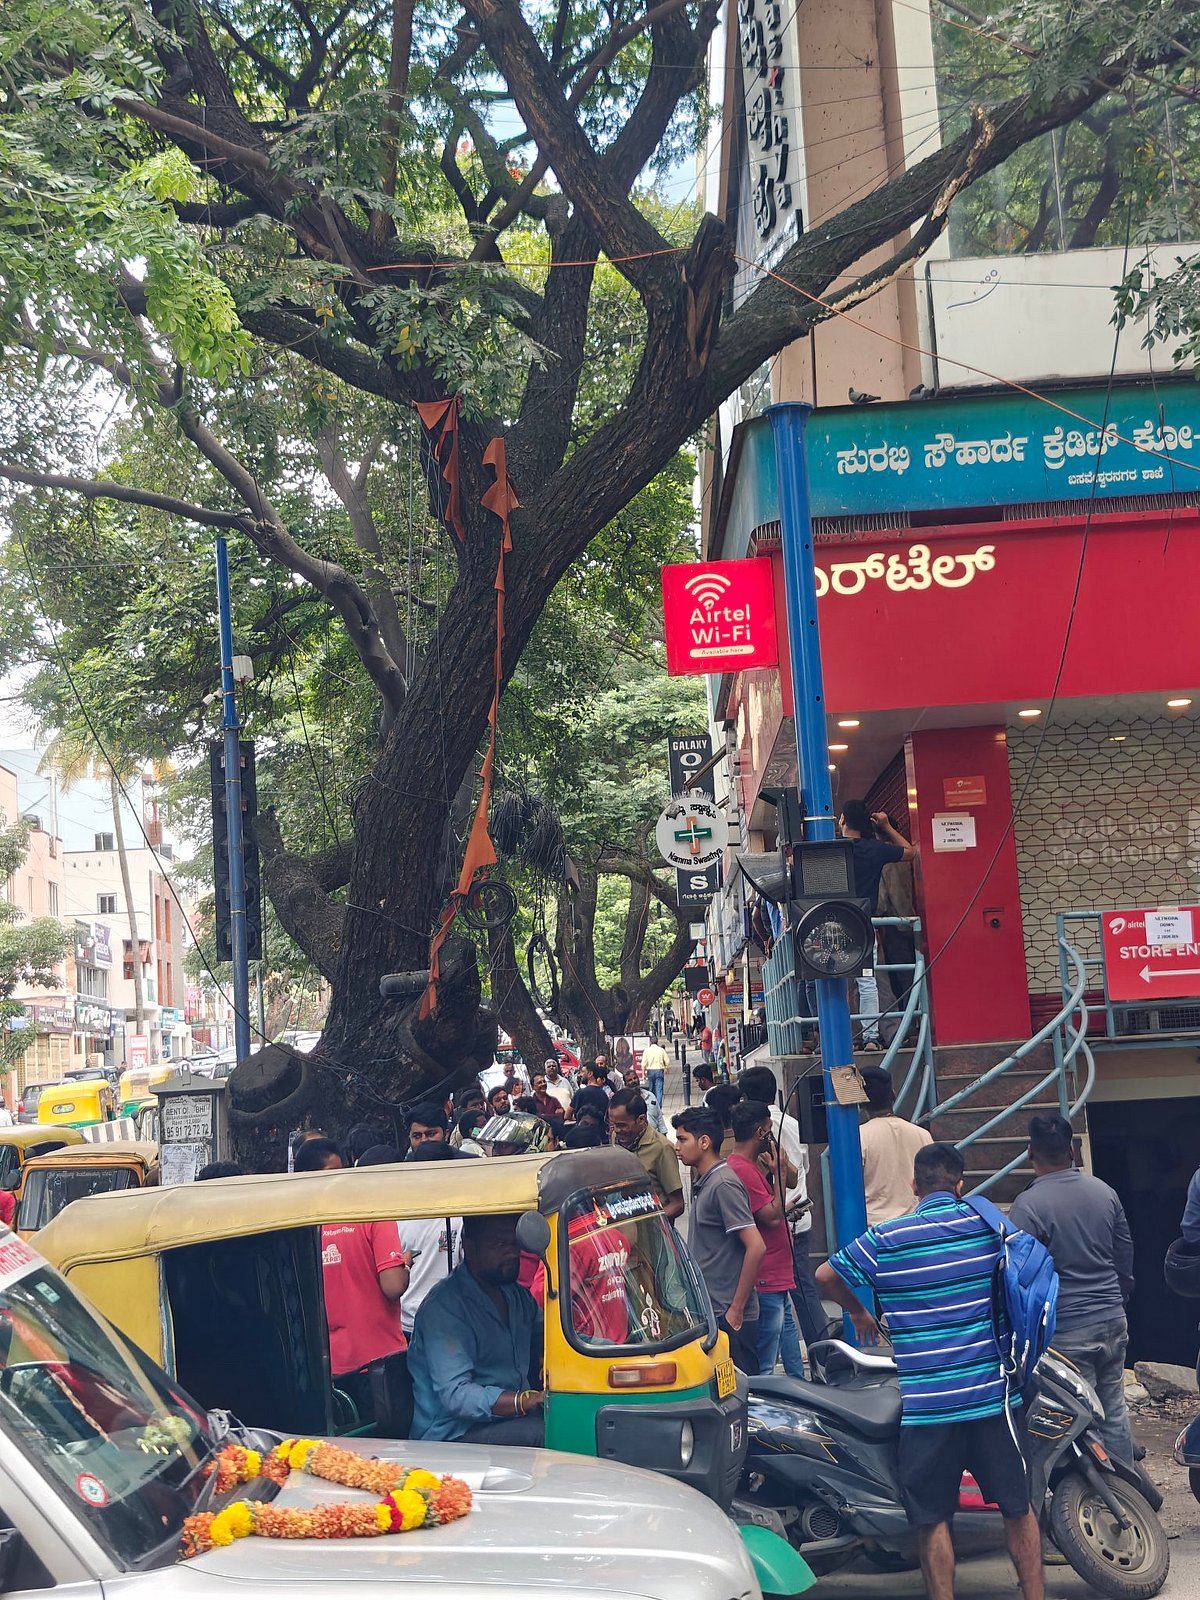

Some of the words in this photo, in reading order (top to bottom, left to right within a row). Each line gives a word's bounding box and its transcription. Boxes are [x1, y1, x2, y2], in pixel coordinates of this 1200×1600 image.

[836, 441, 911, 475] ಸುರಭಿ
[1043, 422, 1119, 469] ಕ್ರೆಡಿಟ್
[689, 603, 751, 625] Airtel
[691, 624, 751, 645] Wi-Fi
[672, 739, 708, 751] GALAXY
[667, 851, 693, 866] Namma
[693, 847, 724, 865] Swasthya
[1127, 921, 1145, 929] airtel
[1119, 944, 1172, 959] STORE
[1176, 942, 1200, 957] EN
